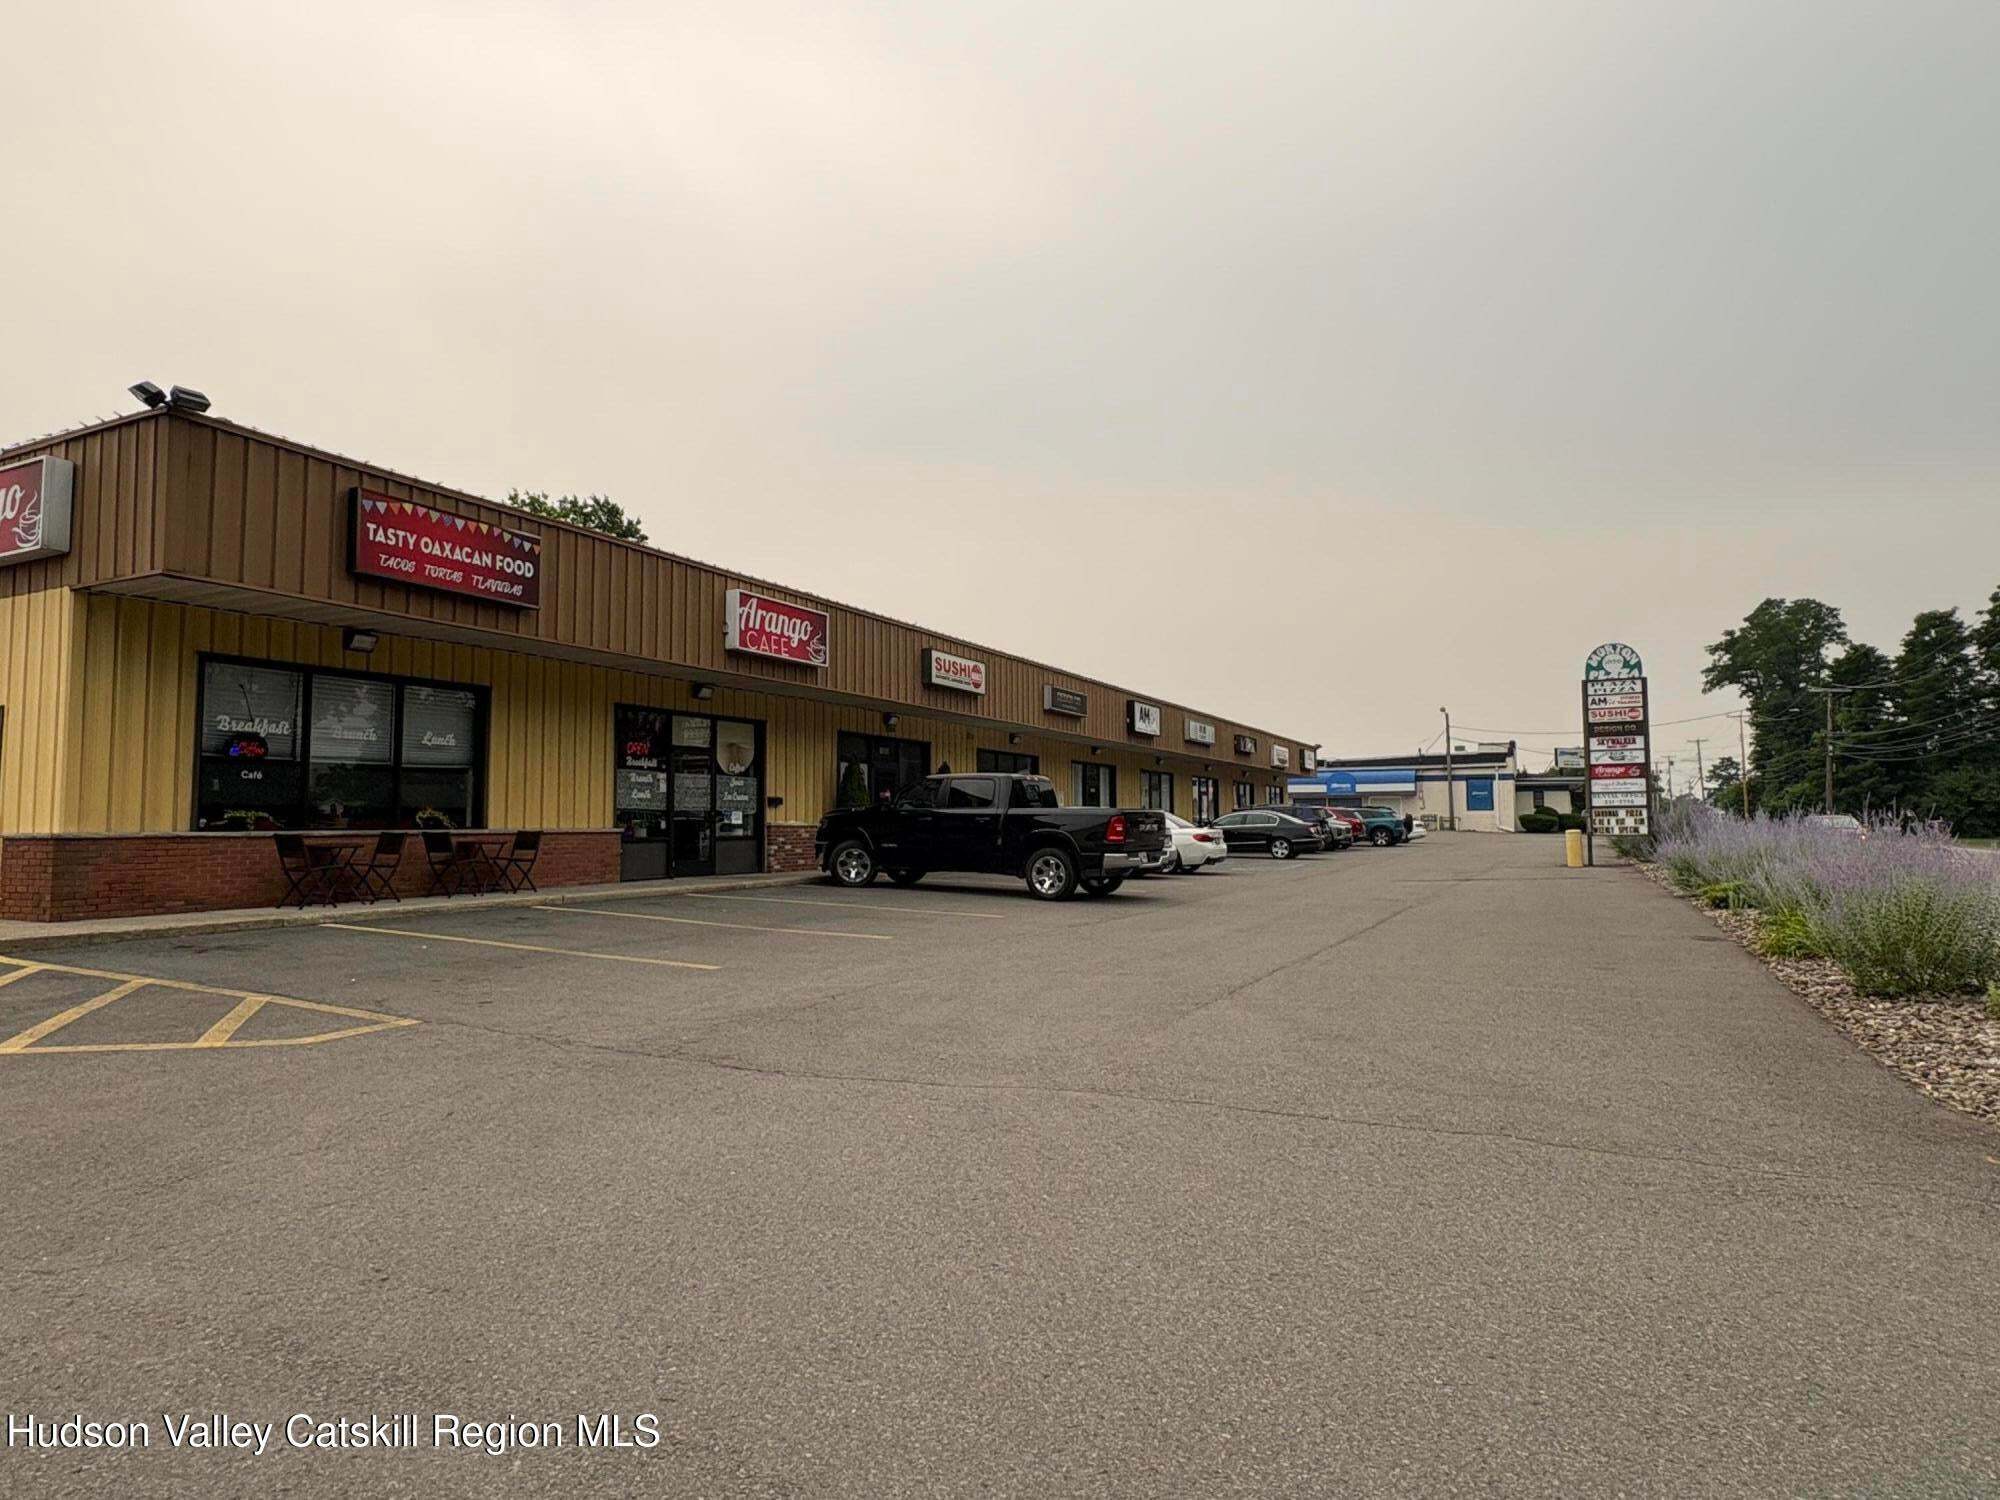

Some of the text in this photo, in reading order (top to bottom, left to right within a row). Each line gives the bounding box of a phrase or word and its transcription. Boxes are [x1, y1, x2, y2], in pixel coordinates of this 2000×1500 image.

[366, 522, 535, 578] TASTY OAXACAN FOOD
[379, 553, 524, 597] TACOS TORTAS TLAYUDAS
[739, 597, 813, 648] Arango
[746, 630, 790, 657] CAFE
[934, 656, 971, 679] SUSHI
[216, 714, 292, 738] Breakfast
[1590, 709, 1627, 719] SUSHI
[421, 731, 457, 746] Lunch
